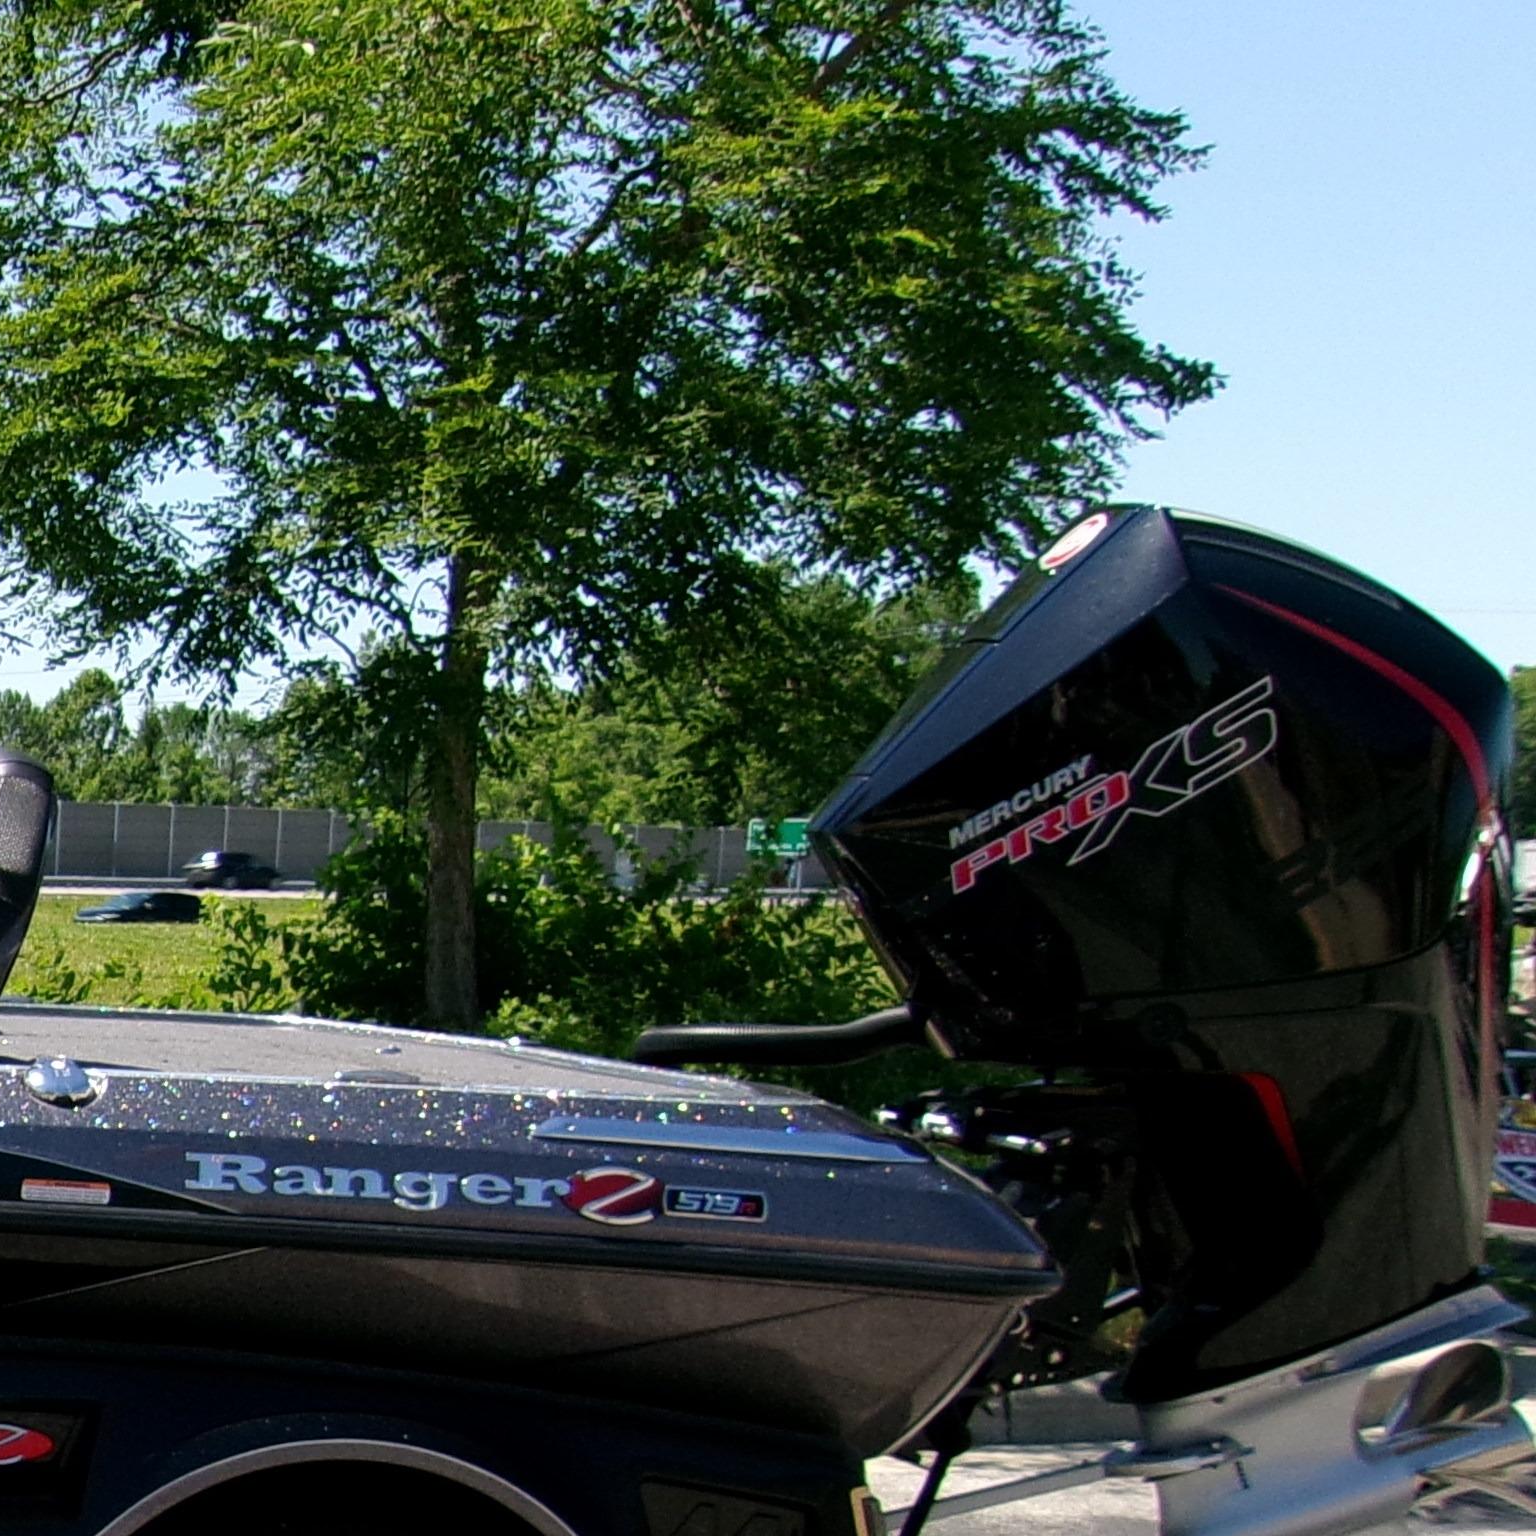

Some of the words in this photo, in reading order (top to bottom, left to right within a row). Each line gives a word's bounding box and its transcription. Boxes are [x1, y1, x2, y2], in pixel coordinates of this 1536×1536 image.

[948, 754, 1092, 850] MERCURY
[950, 771, 1130, 894] PRO
[1066, 674, 1277, 867] XS
[185, 1151, 571, 1210] Ranger
